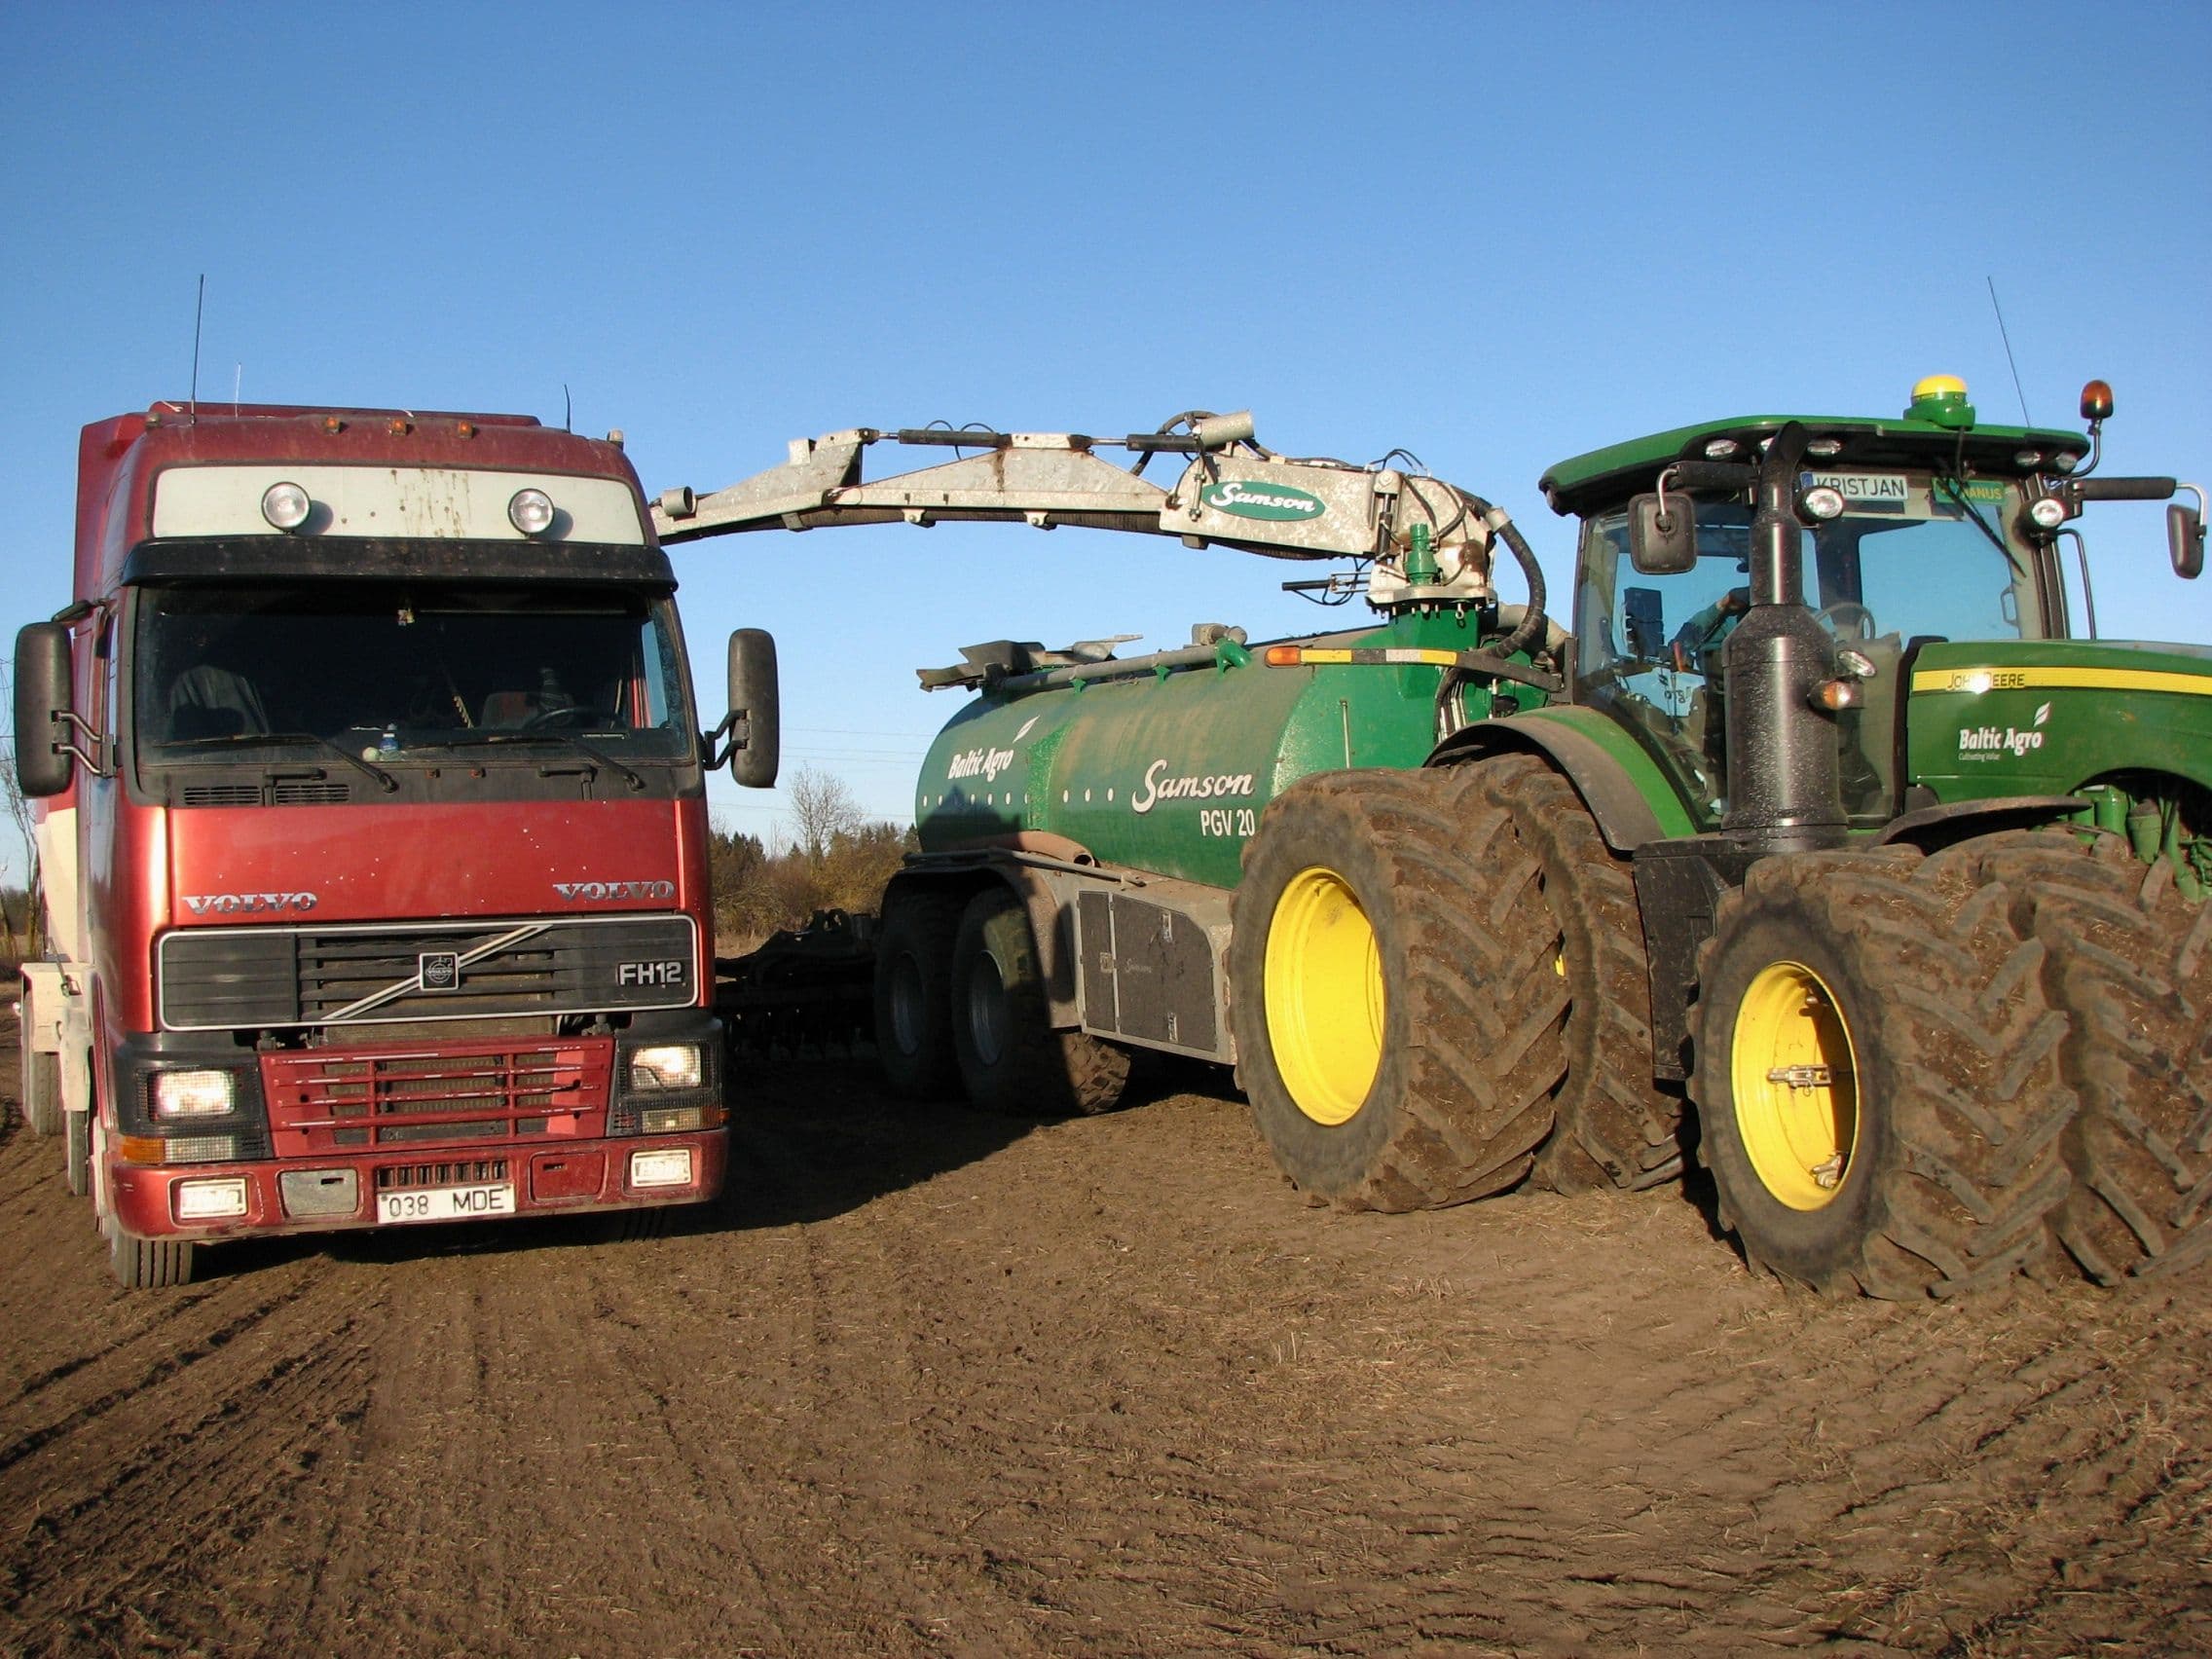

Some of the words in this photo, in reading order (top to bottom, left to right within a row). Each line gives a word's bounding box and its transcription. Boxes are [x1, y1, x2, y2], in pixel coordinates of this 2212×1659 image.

[1210, 482, 1316, 513] Samson
[1817, 477, 1905, 497] KRISTJAN
[1958, 726, 2001, 750] Baltic
[2003, 727, 2043, 756] Agro
[947, 747, 984, 780] Baltic
[979, 747, 1014, 783] Agro
[1131, 758, 1255, 814] Samson
[1199, 809, 1233, 836] PGV
[1235, 808, 1256, 836] 20
[181, 892, 318, 915] VOLVO
[552, 880, 676, 902] VOLVO
[619, 961, 682, 986] FH12
[388, 1194, 429, 1218] 038
[453, 1188, 504, 1213] MDE
